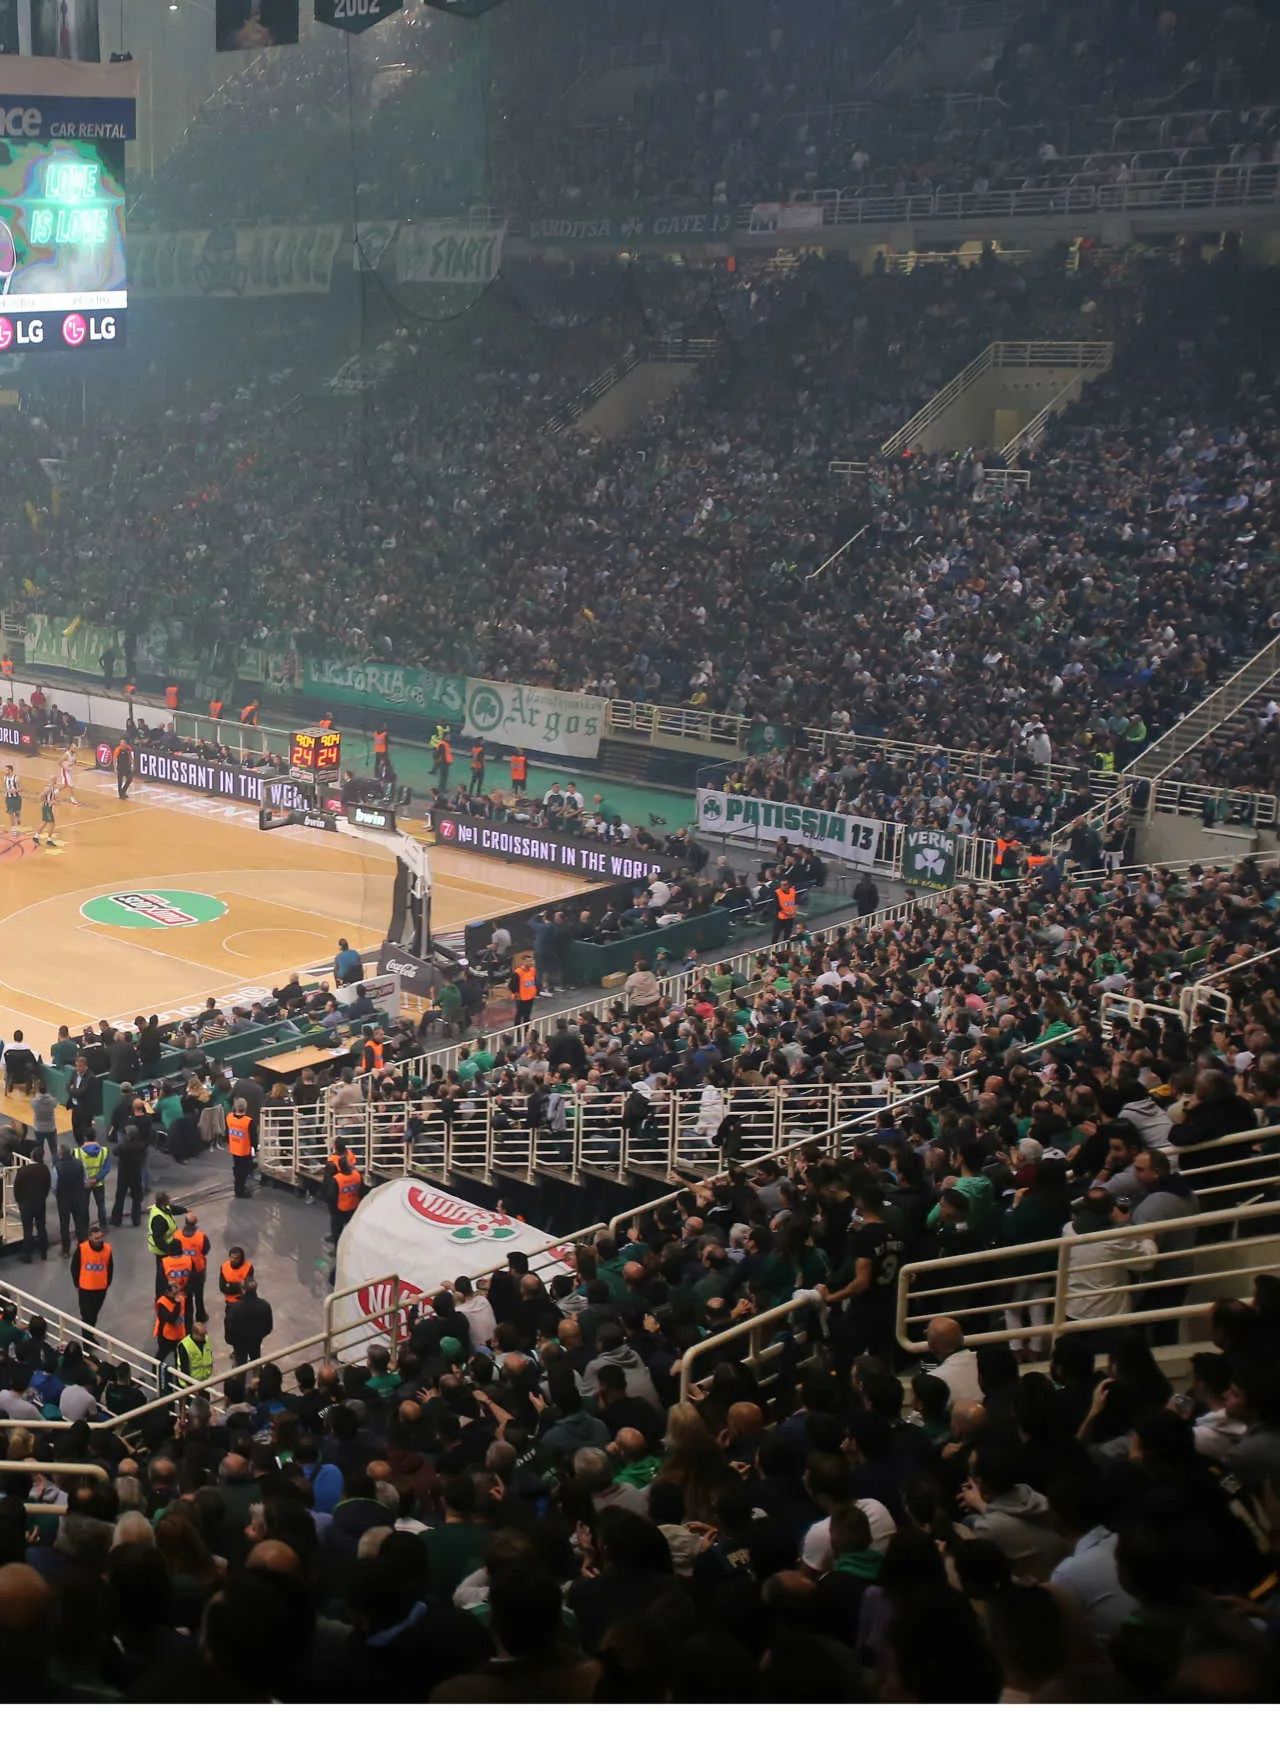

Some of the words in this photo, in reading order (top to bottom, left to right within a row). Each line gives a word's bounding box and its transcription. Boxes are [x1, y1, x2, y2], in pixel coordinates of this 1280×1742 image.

[50, 122, 77, 137] CAR
[79, 123, 126, 139] RENTAL
[30, 209, 53, 244] IS
[652, 214, 705, 236] GATE
[16, 319, 44, 344] LG
[90, 316, 116, 340] LG
[502, 685, 599, 743] Argos
[292, 747, 313, 765] 24
[317, 747, 338, 766] 24
[139, 752, 215, 789] CROISSANT
[220, 770, 234, 794] IN
[354, 807, 387, 827] bwin
[726, 797, 847, 843] PATISSIA
[850, 823, 875, 850] 13
[483, 830, 556, 861] CROISSANT
[562, 845, 576, 865] IN
[580, 850, 606, 873] THE
